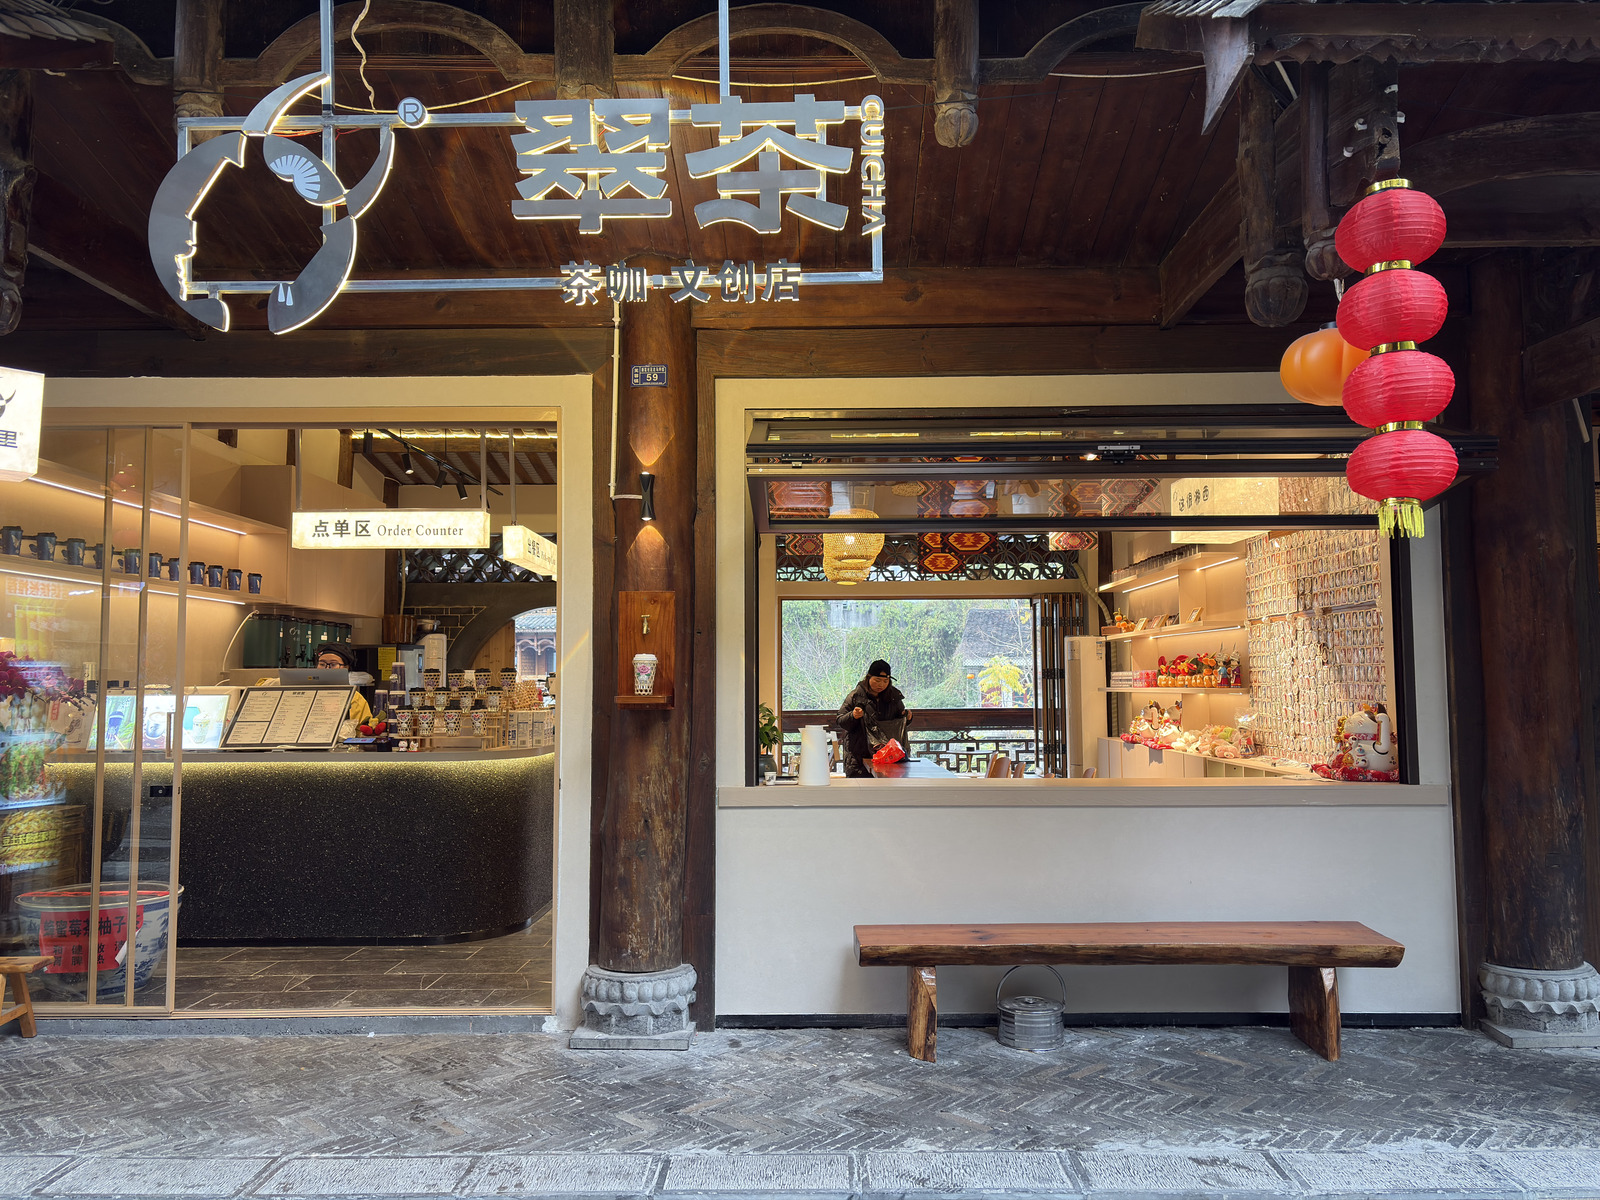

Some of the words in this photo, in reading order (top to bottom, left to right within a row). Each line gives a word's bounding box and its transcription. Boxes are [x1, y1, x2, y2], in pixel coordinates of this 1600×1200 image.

[646, 373, 658, 381] 59
[312, 519, 371, 537] 点单区
[377, 524, 412, 536] Order
[415, 524, 463, 536] Counter
